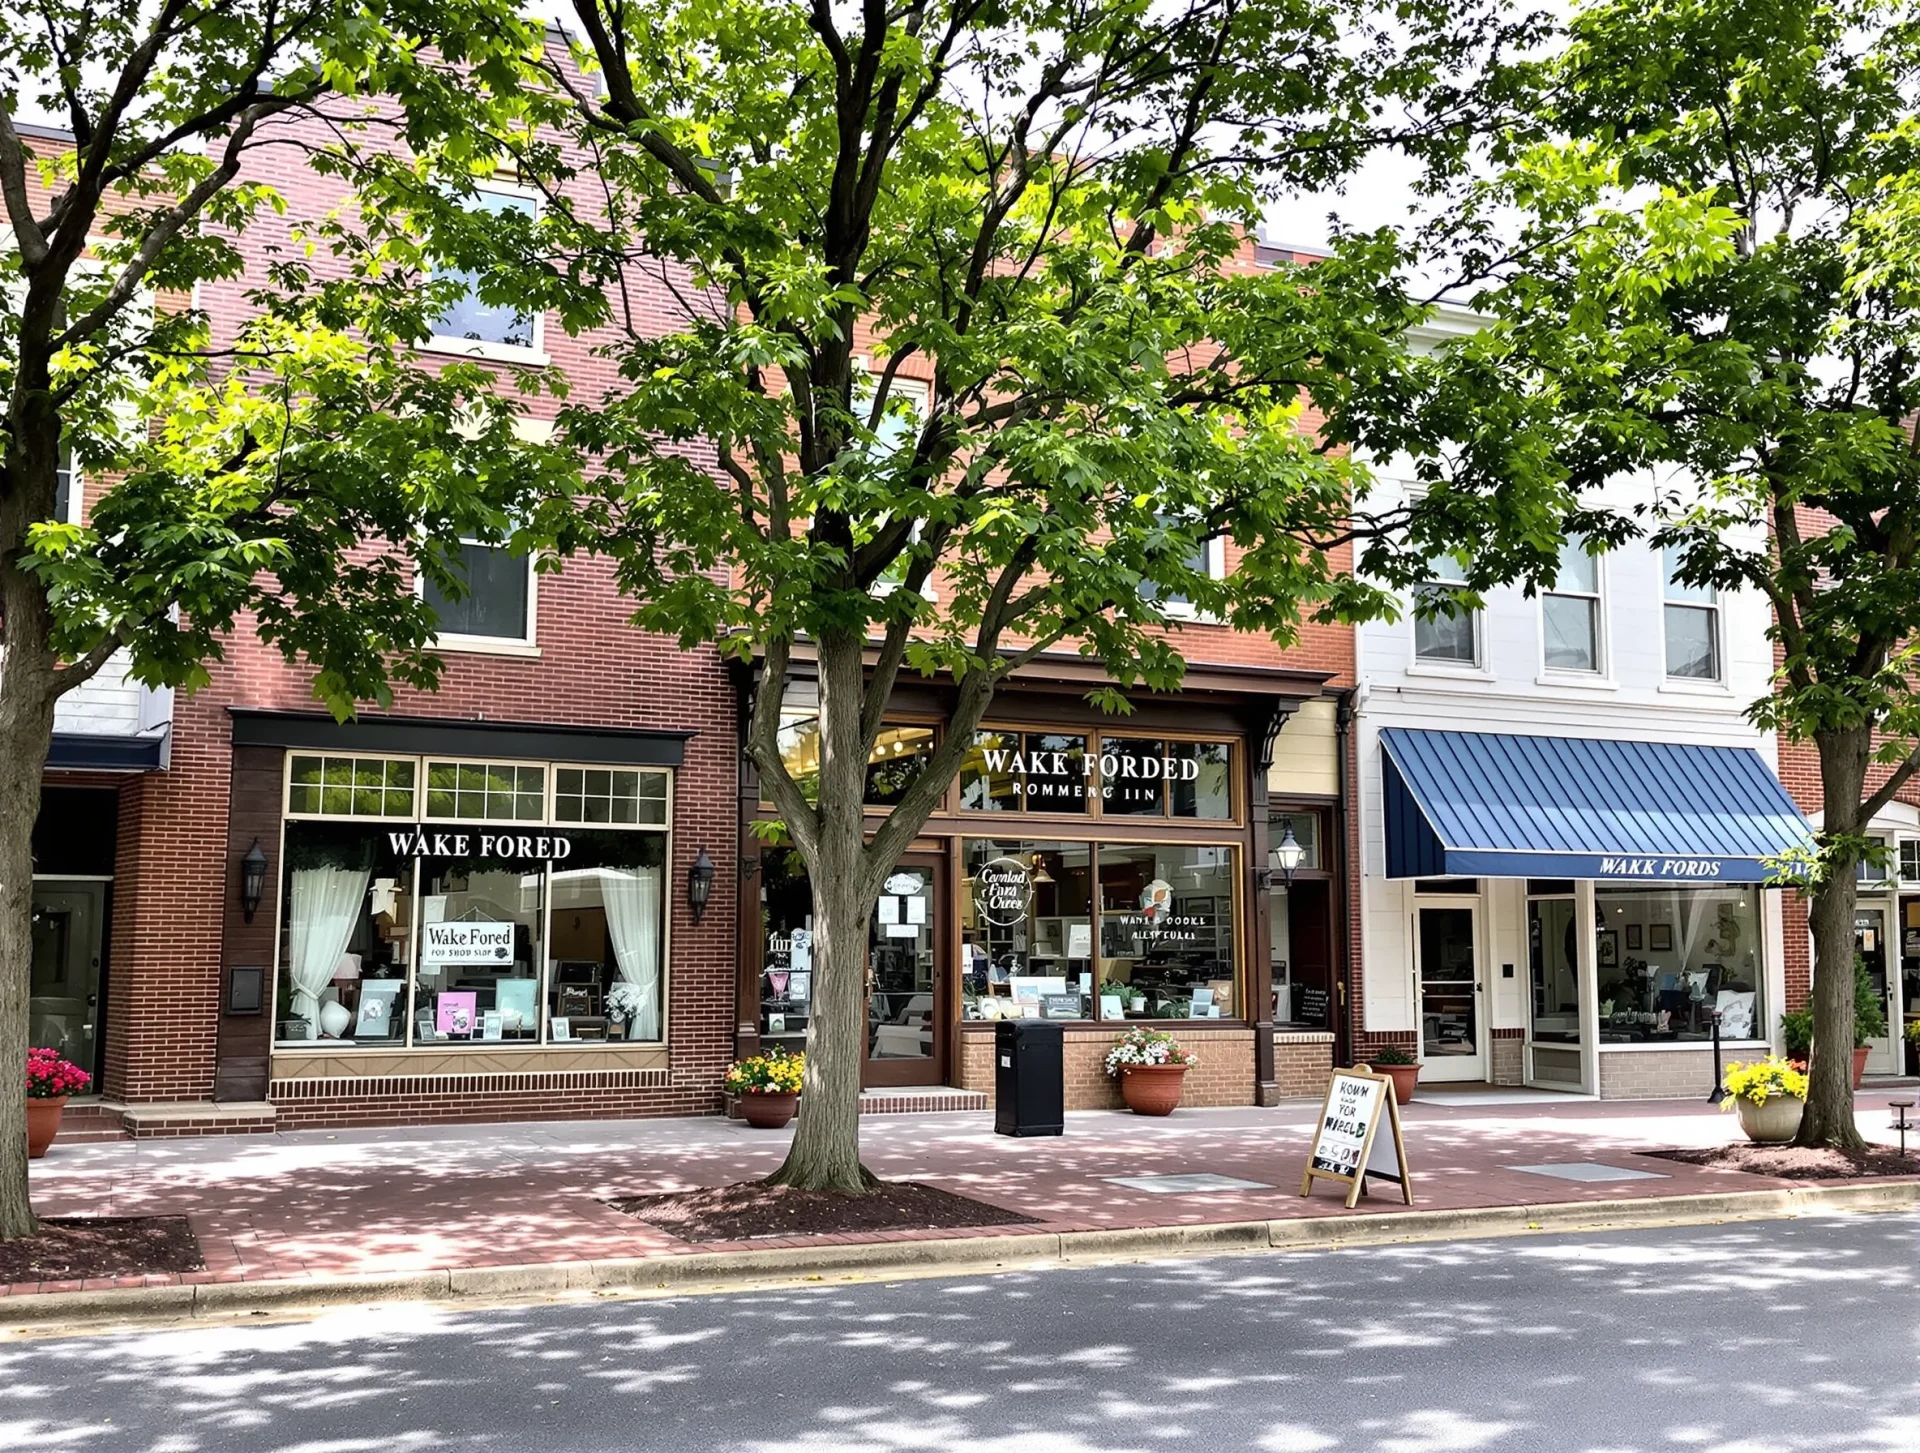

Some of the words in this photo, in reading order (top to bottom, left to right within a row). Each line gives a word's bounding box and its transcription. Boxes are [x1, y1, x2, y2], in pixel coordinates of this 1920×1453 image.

[1082, 753, 1199, 781] FORDED
[388, 832, 470, 857] WAKE
[479, 835, 571, 859] FORED
[1660, 859, 1721, 876] FORDS
[429, 927, 467, 946] Wake
[470, 924, 510, 945] Fored
